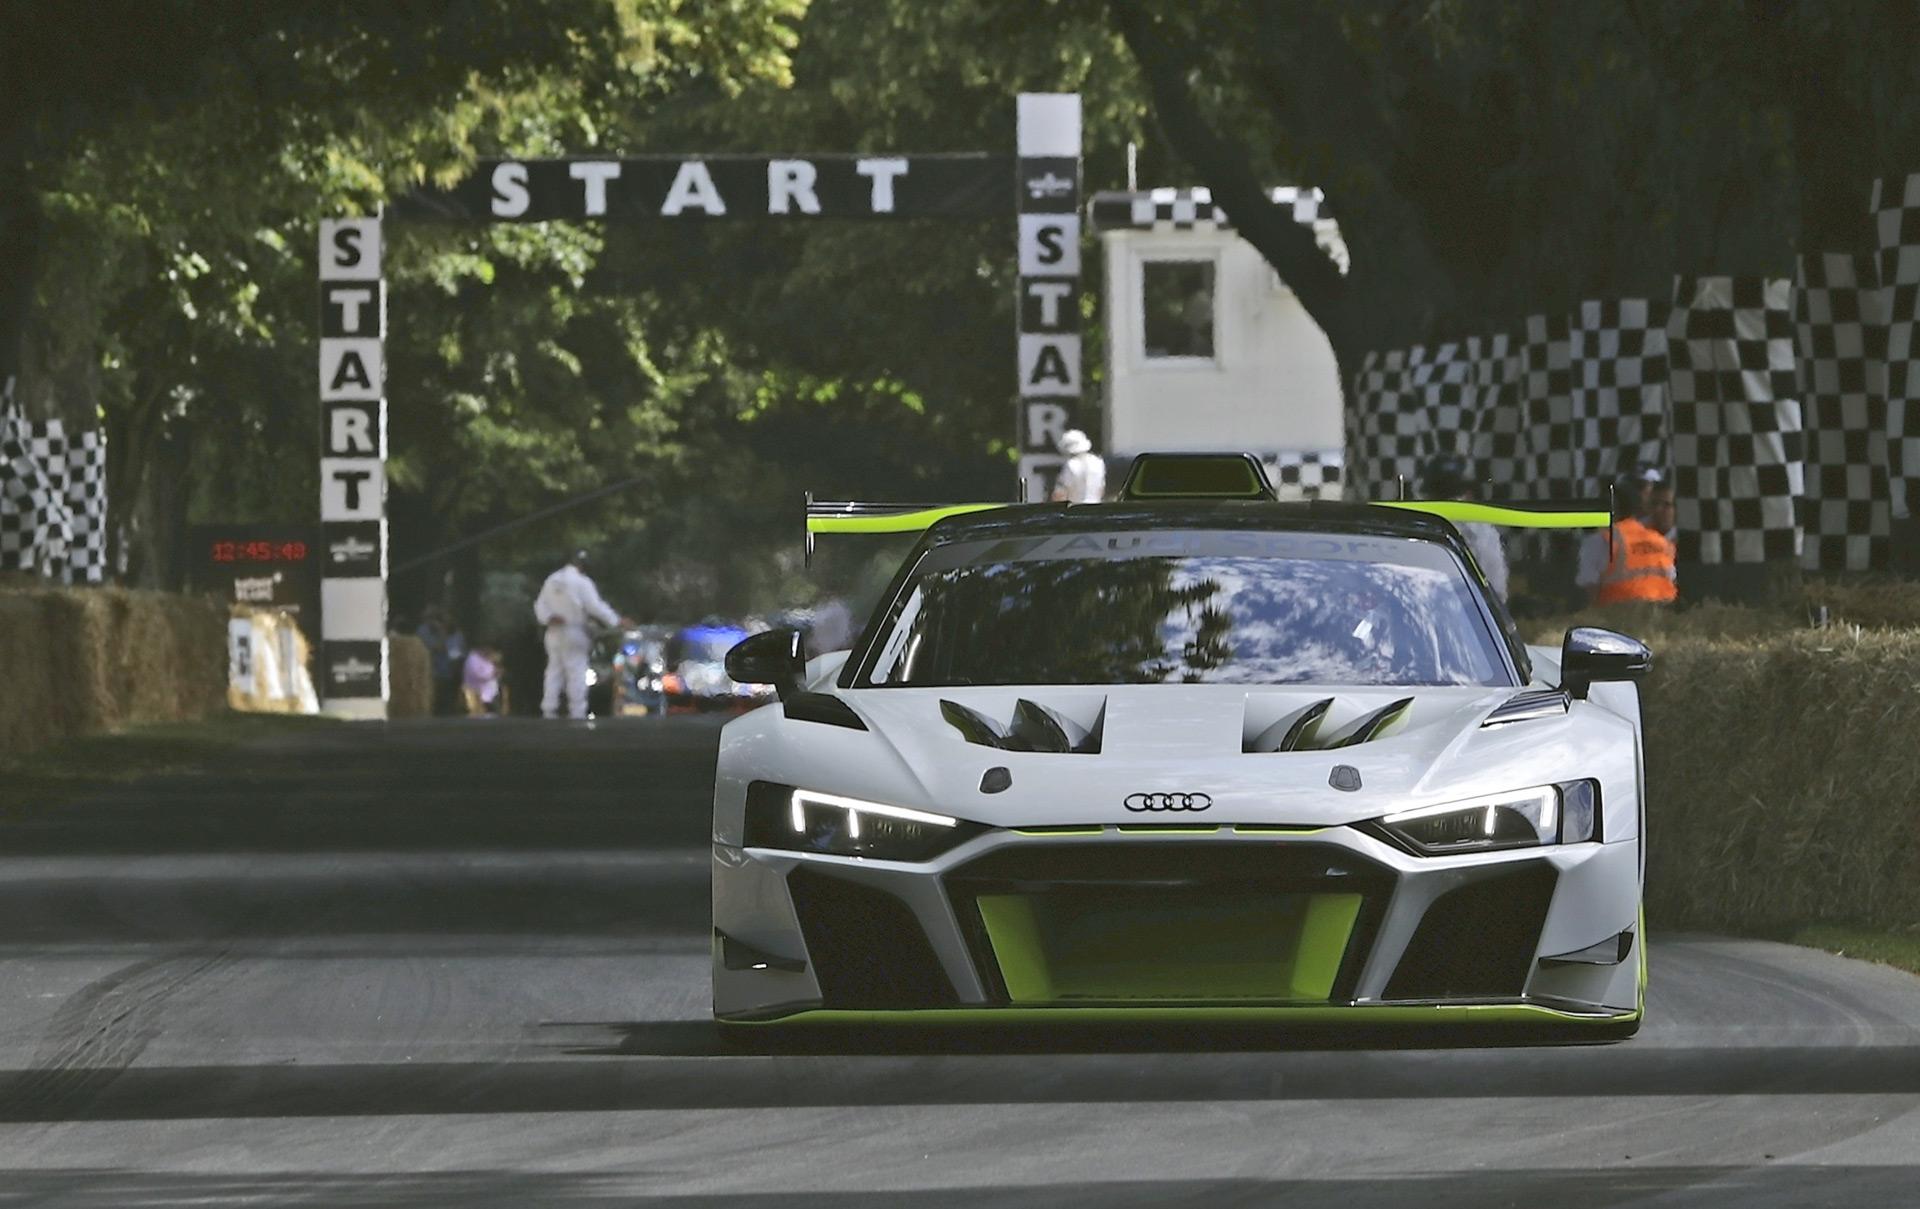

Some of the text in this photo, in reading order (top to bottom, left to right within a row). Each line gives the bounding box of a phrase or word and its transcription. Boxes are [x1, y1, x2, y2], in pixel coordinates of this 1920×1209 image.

[491, 159, 909, 217] START
[330, 228, 373, 511] START
[1028, 226, 1072, 502] START
